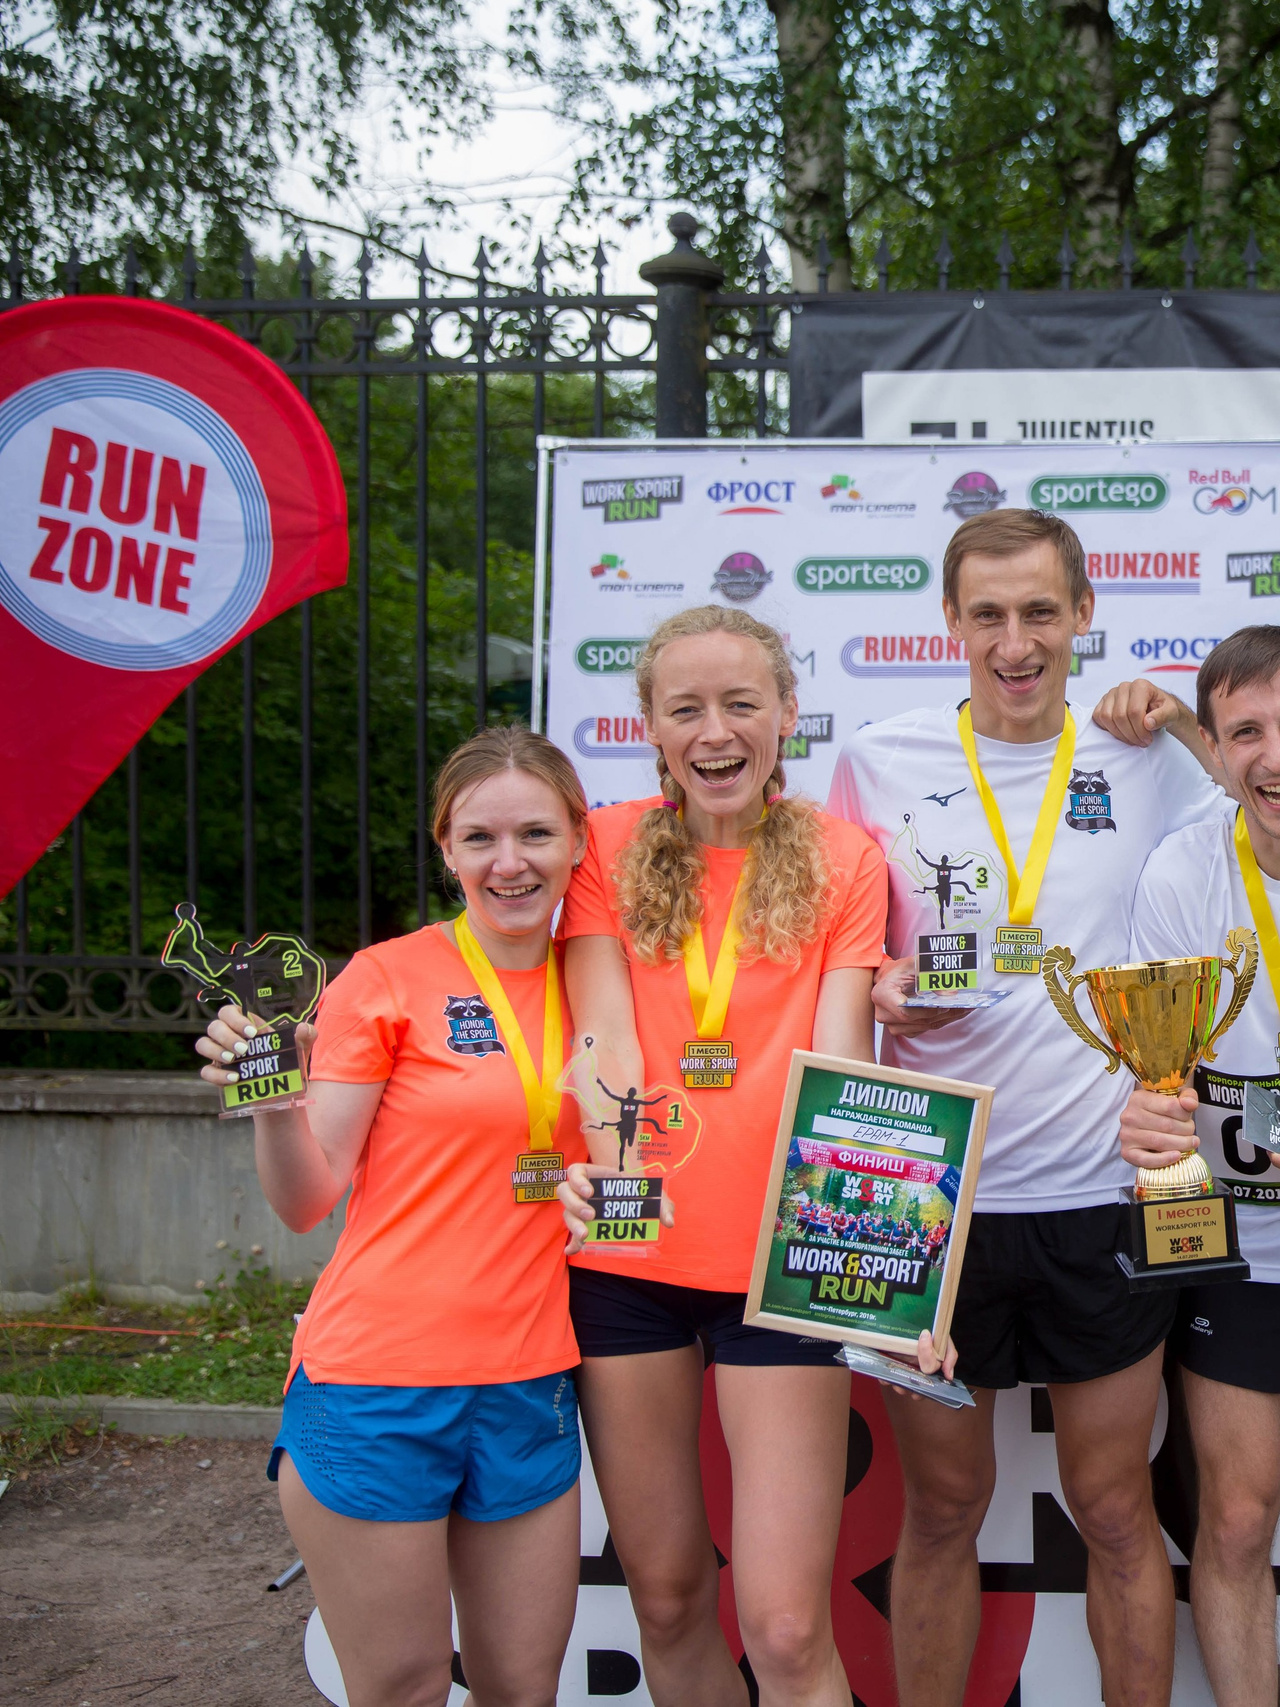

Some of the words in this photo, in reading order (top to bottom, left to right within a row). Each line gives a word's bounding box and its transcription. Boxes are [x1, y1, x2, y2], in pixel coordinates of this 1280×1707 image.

[41, 427, 207, 542] RUN
[1189, 470, 1219, 485] Red
[1222, 470, 1250, 484] Bull
[584, 478, 681, 504] WORK&SPORT
[707, 482, 796, 503] ФРОСТ
[1039, 480, 1157, 508] sportego
[608, 500, 658, 521] RUN
[29, 517, 197, 616] ZONE
[1088, 553, 1200, 578] RUNZONE
[805, 561, 921, 590] sportego
[1079, 796, 1102, 805] HONOR
[1074, 806, 1086, 814] THE
[1087, 805, 1108, 815] SPORT
[976, 867, 988, 883] 3
[929, 935, 966, 951] WORK&
[991, 942, 1047, 955] WORK&SPORT
[282, 950, 301, 971] 2
[932, 954, 963, 970] SPORT
[1003, 959, 1032, 970] RUN
[929, 973, 968, 989] RUN
[459, 1019, 486, 1030] HONOR
[455, 1030, 470, 1039] THE
[470, 1029, 494, 1039] SPORT
[240, 1055, 280, 1080] SPORT
[679, 1057, 738, 1070] WORK&SPORT
[693, 1074, 724, 1085] RUN
[237, 1075, 290, 1103] RUN
[838, 1080, 930, 1118] ДИПЛОМ
[670, 1104, 682, 1122] 1
[830, 1107, 893, 1126] НАГРАЖДАЕТСЯ
[893, 1119, 932, 1134] КОМАНДА
[838, 1150, 905, 1173] ФИНИШ
[512, 1169, 567, 1184] WORK&SPORT
[525, 1186, 554, 1199] RUN
[602, 1179, 649, 1197] WORK&
[604, 1201, 644, 1218] SPORT
[596, 1222, 648, 1240] RUN
[1155, 1222, 1201, 1232] WORK&SPORT
[808, 1234, 816, 1242] ЗА
[817, 1236, 840, 1247] УЧАСТИЕ
[844, 1241, 889, 1254] КОРПОРАТИВНОМ
[889, 1248, 909, 1257] ЗАБЕГЕ
[788, 1246, 924, 1284] WORK&SPORT
[818, 1274, 888, 1305] RUN
[809, 1302, 858, 1318] Санкт-Петербург,
